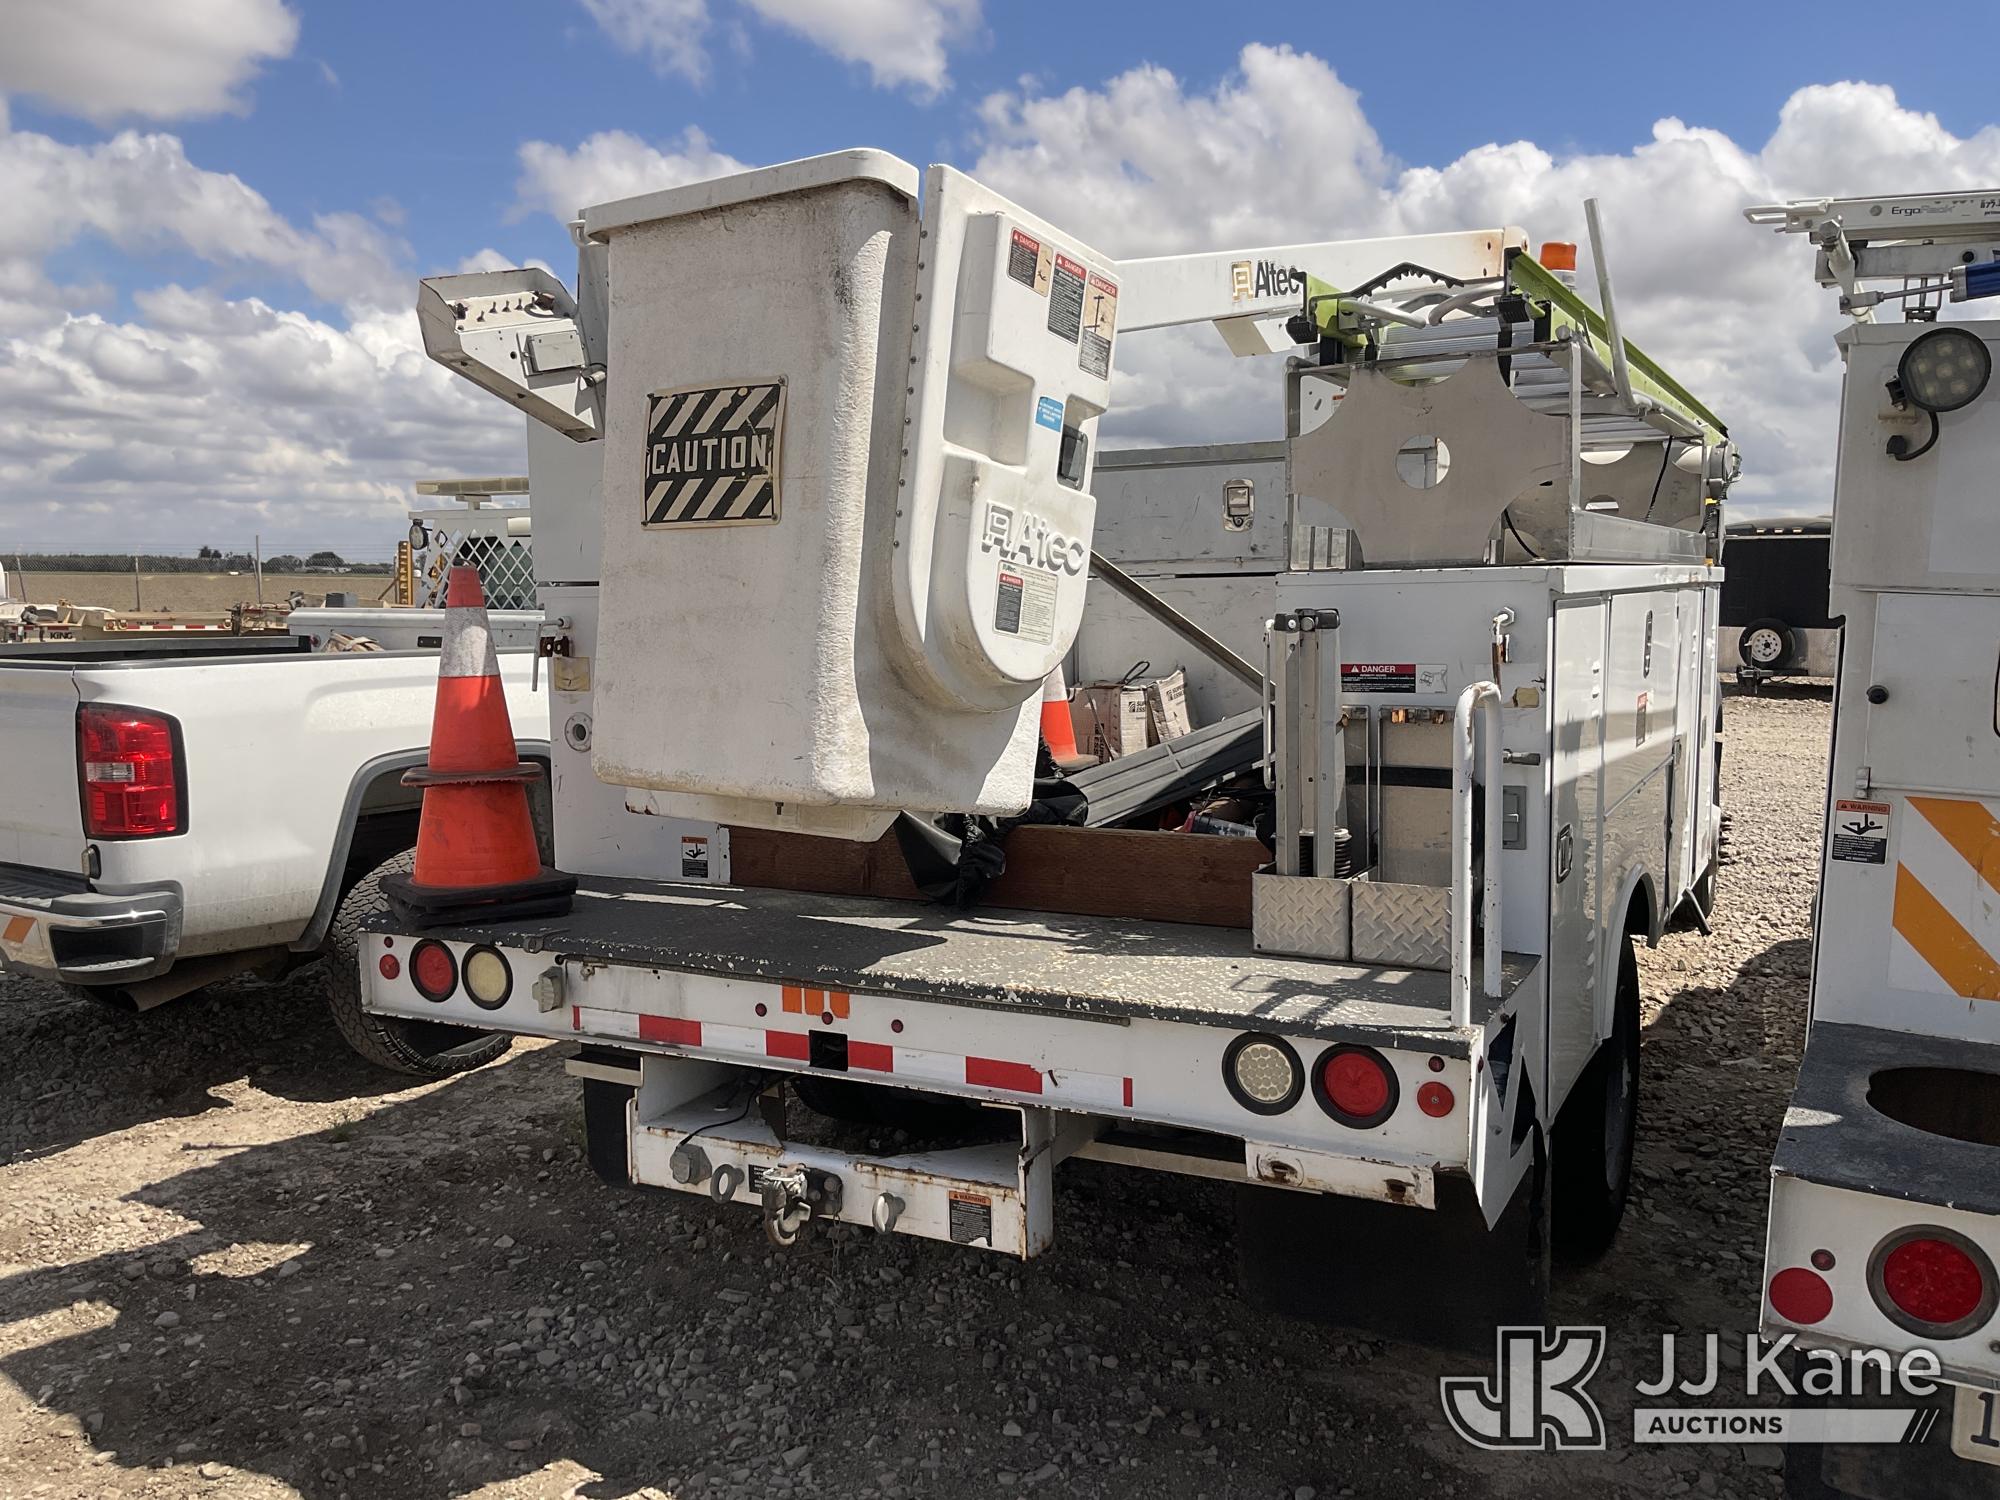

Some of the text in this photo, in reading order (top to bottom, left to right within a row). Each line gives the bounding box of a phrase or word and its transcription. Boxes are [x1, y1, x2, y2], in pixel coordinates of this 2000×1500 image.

[1255, 260, 1300, 298] Altec
[652, 434, 767, 474] CAUTION
[1010, 511, 1085, 577] Altec
[50, 631, 73, 639] KING
[1361, 665, 1396, 673] DANGER
[1849, 803, 1887, 812] WARNING
[959, 1193, 987, 1203] WARNING
